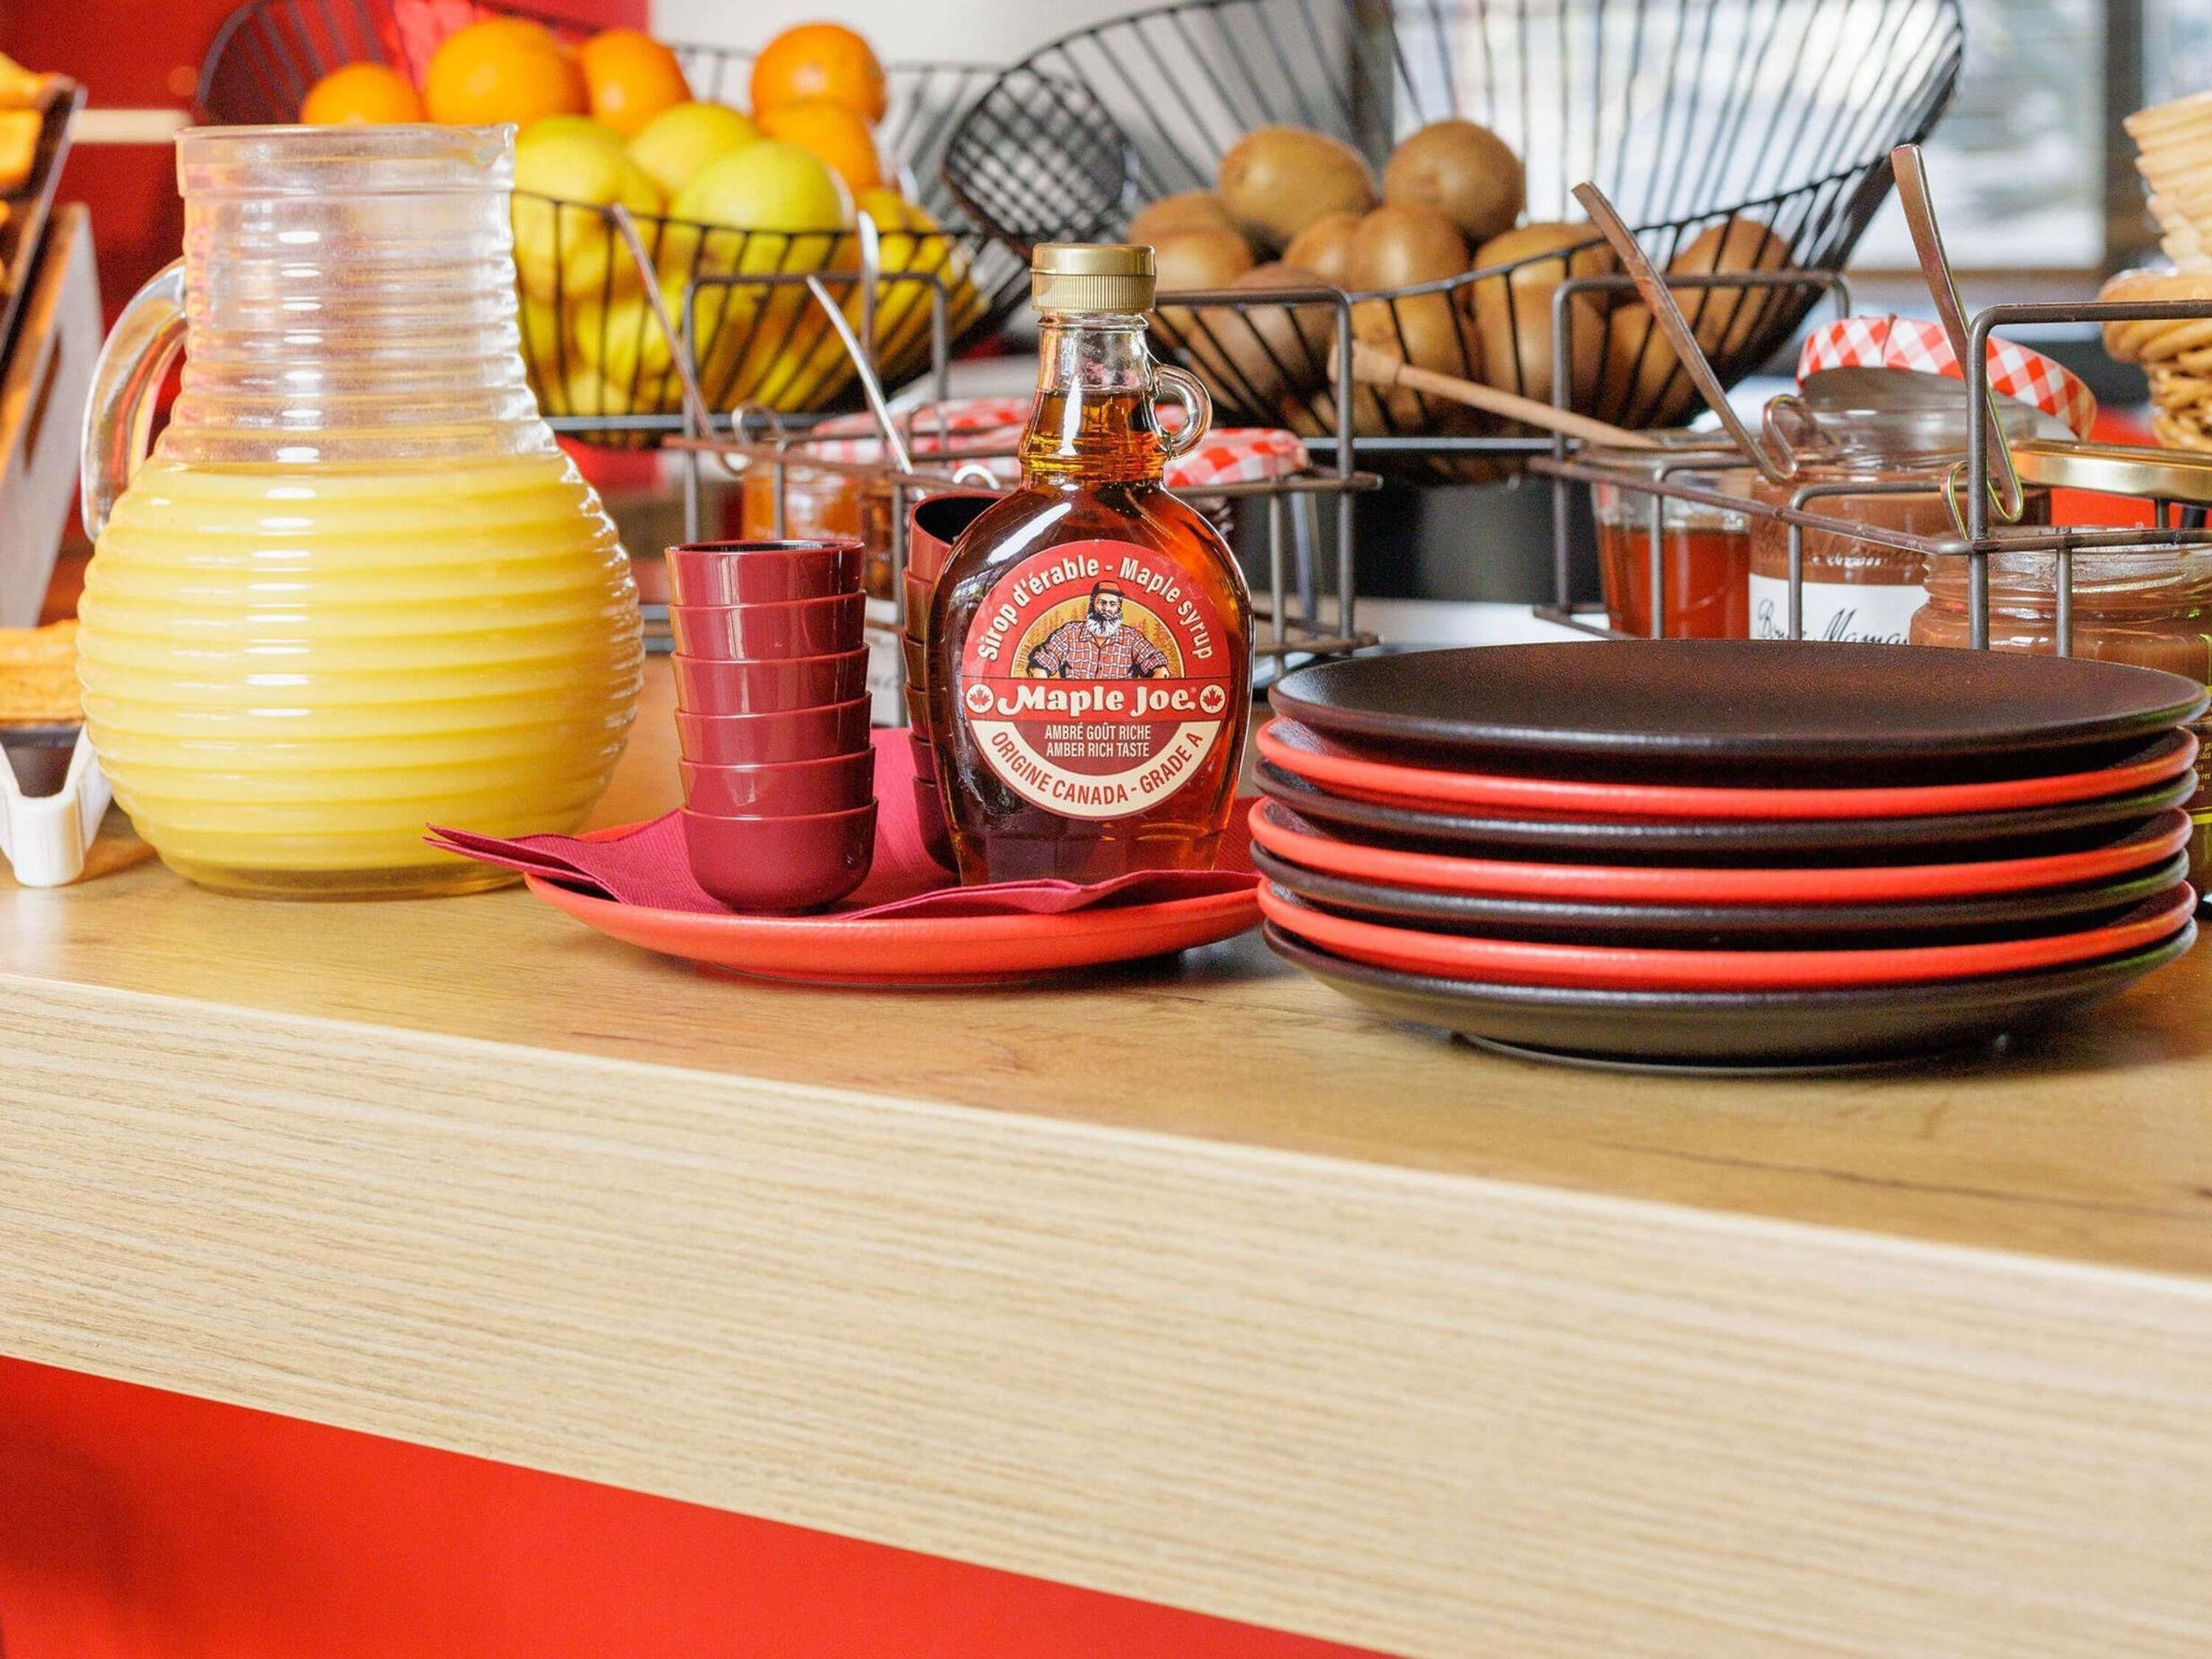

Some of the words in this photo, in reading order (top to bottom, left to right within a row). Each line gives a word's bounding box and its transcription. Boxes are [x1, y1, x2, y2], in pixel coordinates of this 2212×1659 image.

[978, 605, 1018, 661] Sirop
[1013, 554, 1099, 608] d'érable
[1119, 557, 1180, 604] Maple
[1178, 600, 1213, 659] syrup
[997, 684, 1124, 717] Maple
[1130, 685, 1196, 717] Joe
[1045, 722, 1083, 740] AMBRÉ
[1087, 722, 1116, 740] GOÛT
[1119, 725, 1151, 740] RICHE
[1046, 742, 1085, 757] AMBER
[1088, 742, 1113, 757] RICH
[1116, 742, 1150, 757] TASTE
[991, 731, 1052, 792] ORIGINE
[1052, 779, 1128, 805] CANADA
[1140, 746, 1193, 794] GRADE
[1187, 731, 1203, 747] A
